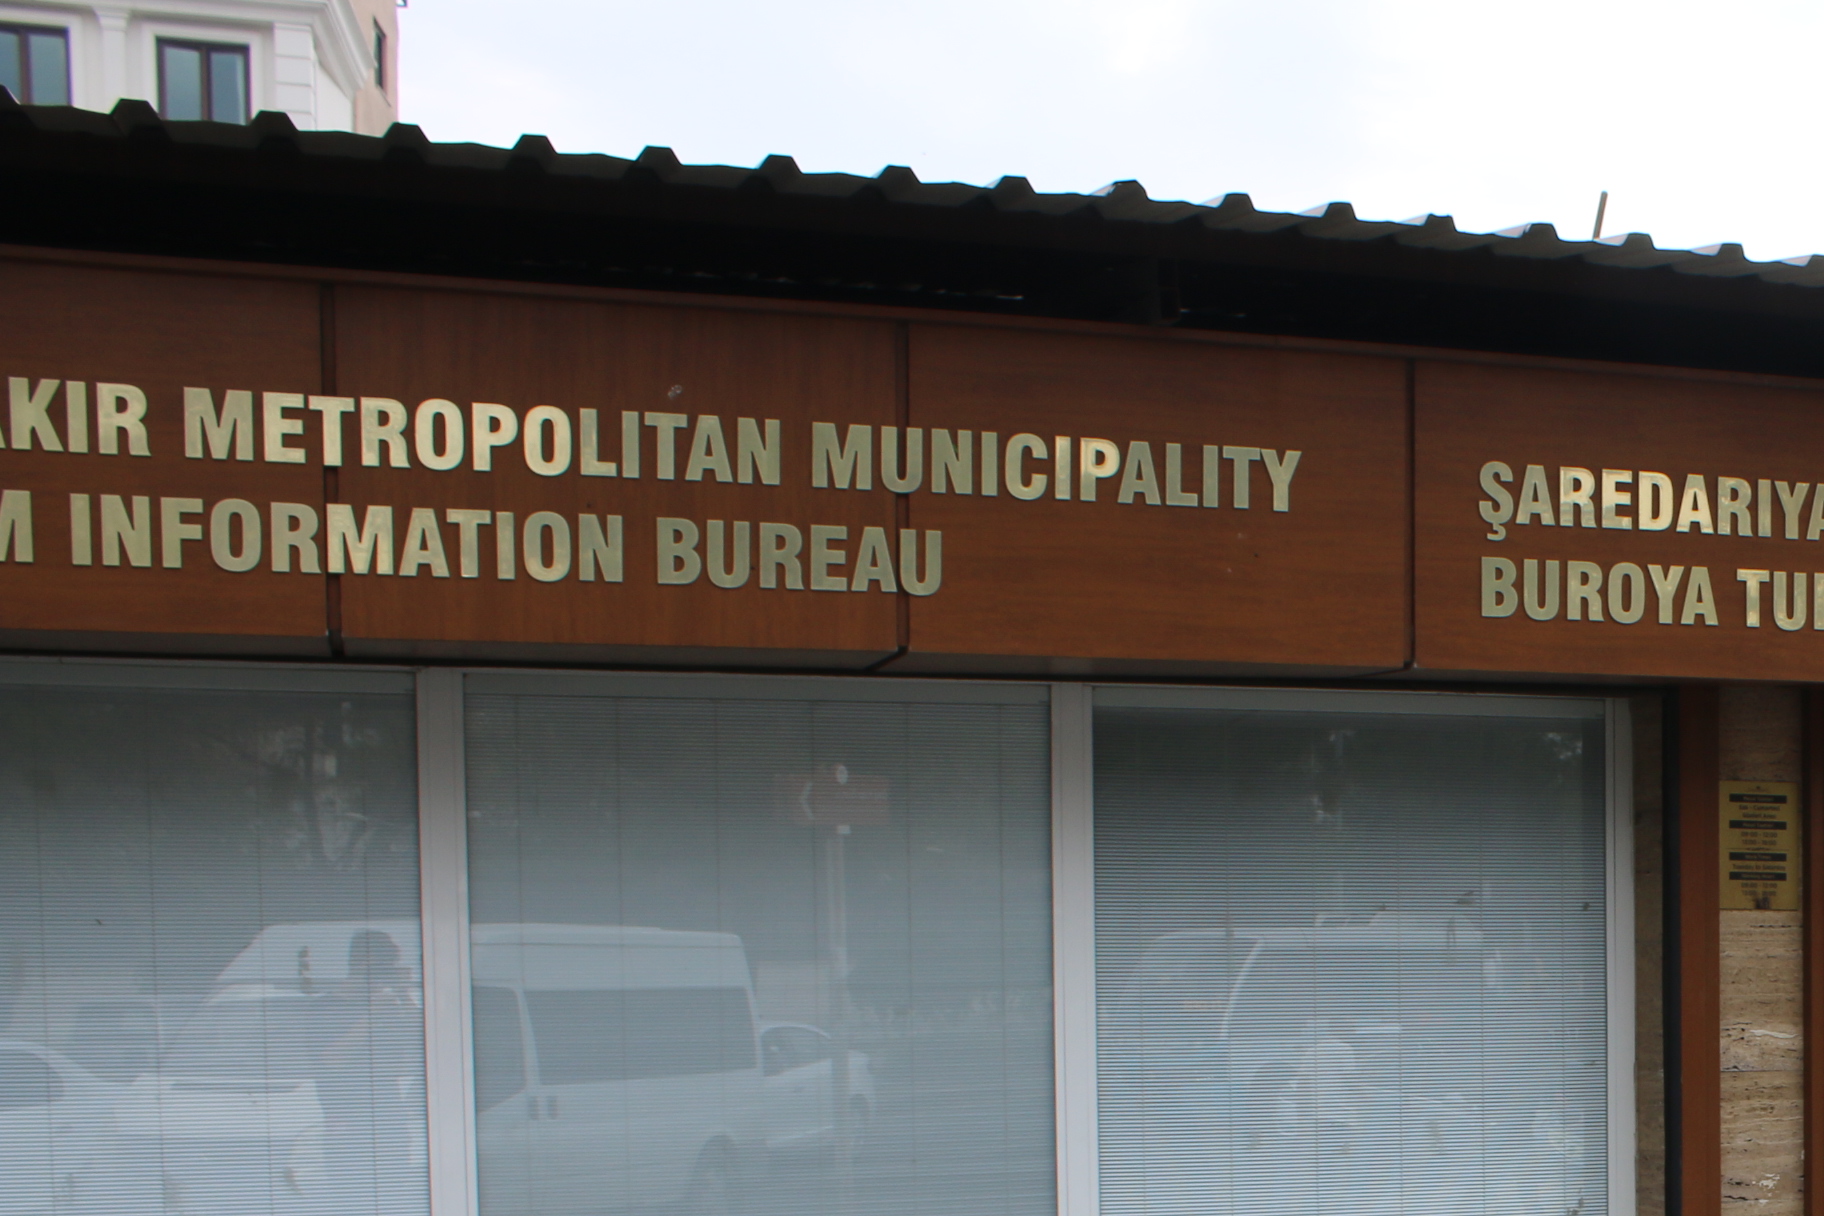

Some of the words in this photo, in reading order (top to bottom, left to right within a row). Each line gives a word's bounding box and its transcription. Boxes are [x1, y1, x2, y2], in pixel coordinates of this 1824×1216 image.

[0, 375, 151, 457] KIR
[183, 385, 782, 487] METROPOLITAN
[811, 420, 1302, 513] MUNICIPALITY
[70, 492, 624, 583] INFORMATION
[656, 516, 943, 597] BUREAU
[1480, 555, 1719, 627] BUROYA
